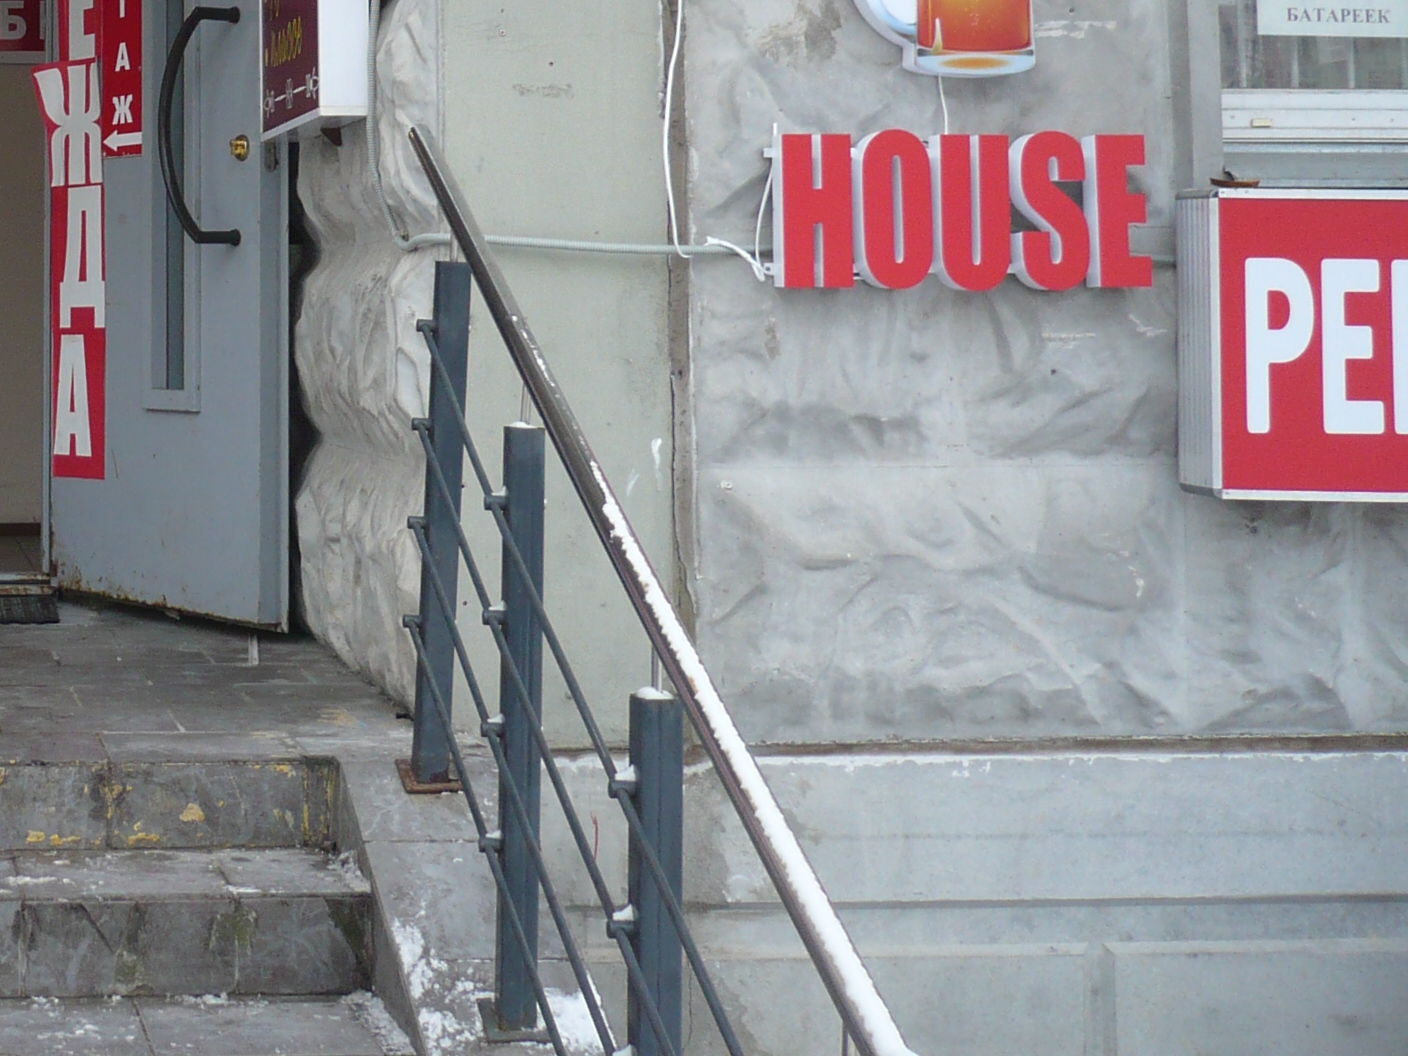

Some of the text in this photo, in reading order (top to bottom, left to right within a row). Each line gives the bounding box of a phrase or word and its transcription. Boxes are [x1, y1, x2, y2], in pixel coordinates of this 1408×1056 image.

[0, 0, 45, 40] Б
[1286, 8, 1391, 24] БАТАРЕЕК
[776, 128, 1153, 291] HOUSE
[1245, 257, 1408, 434] РЕ
